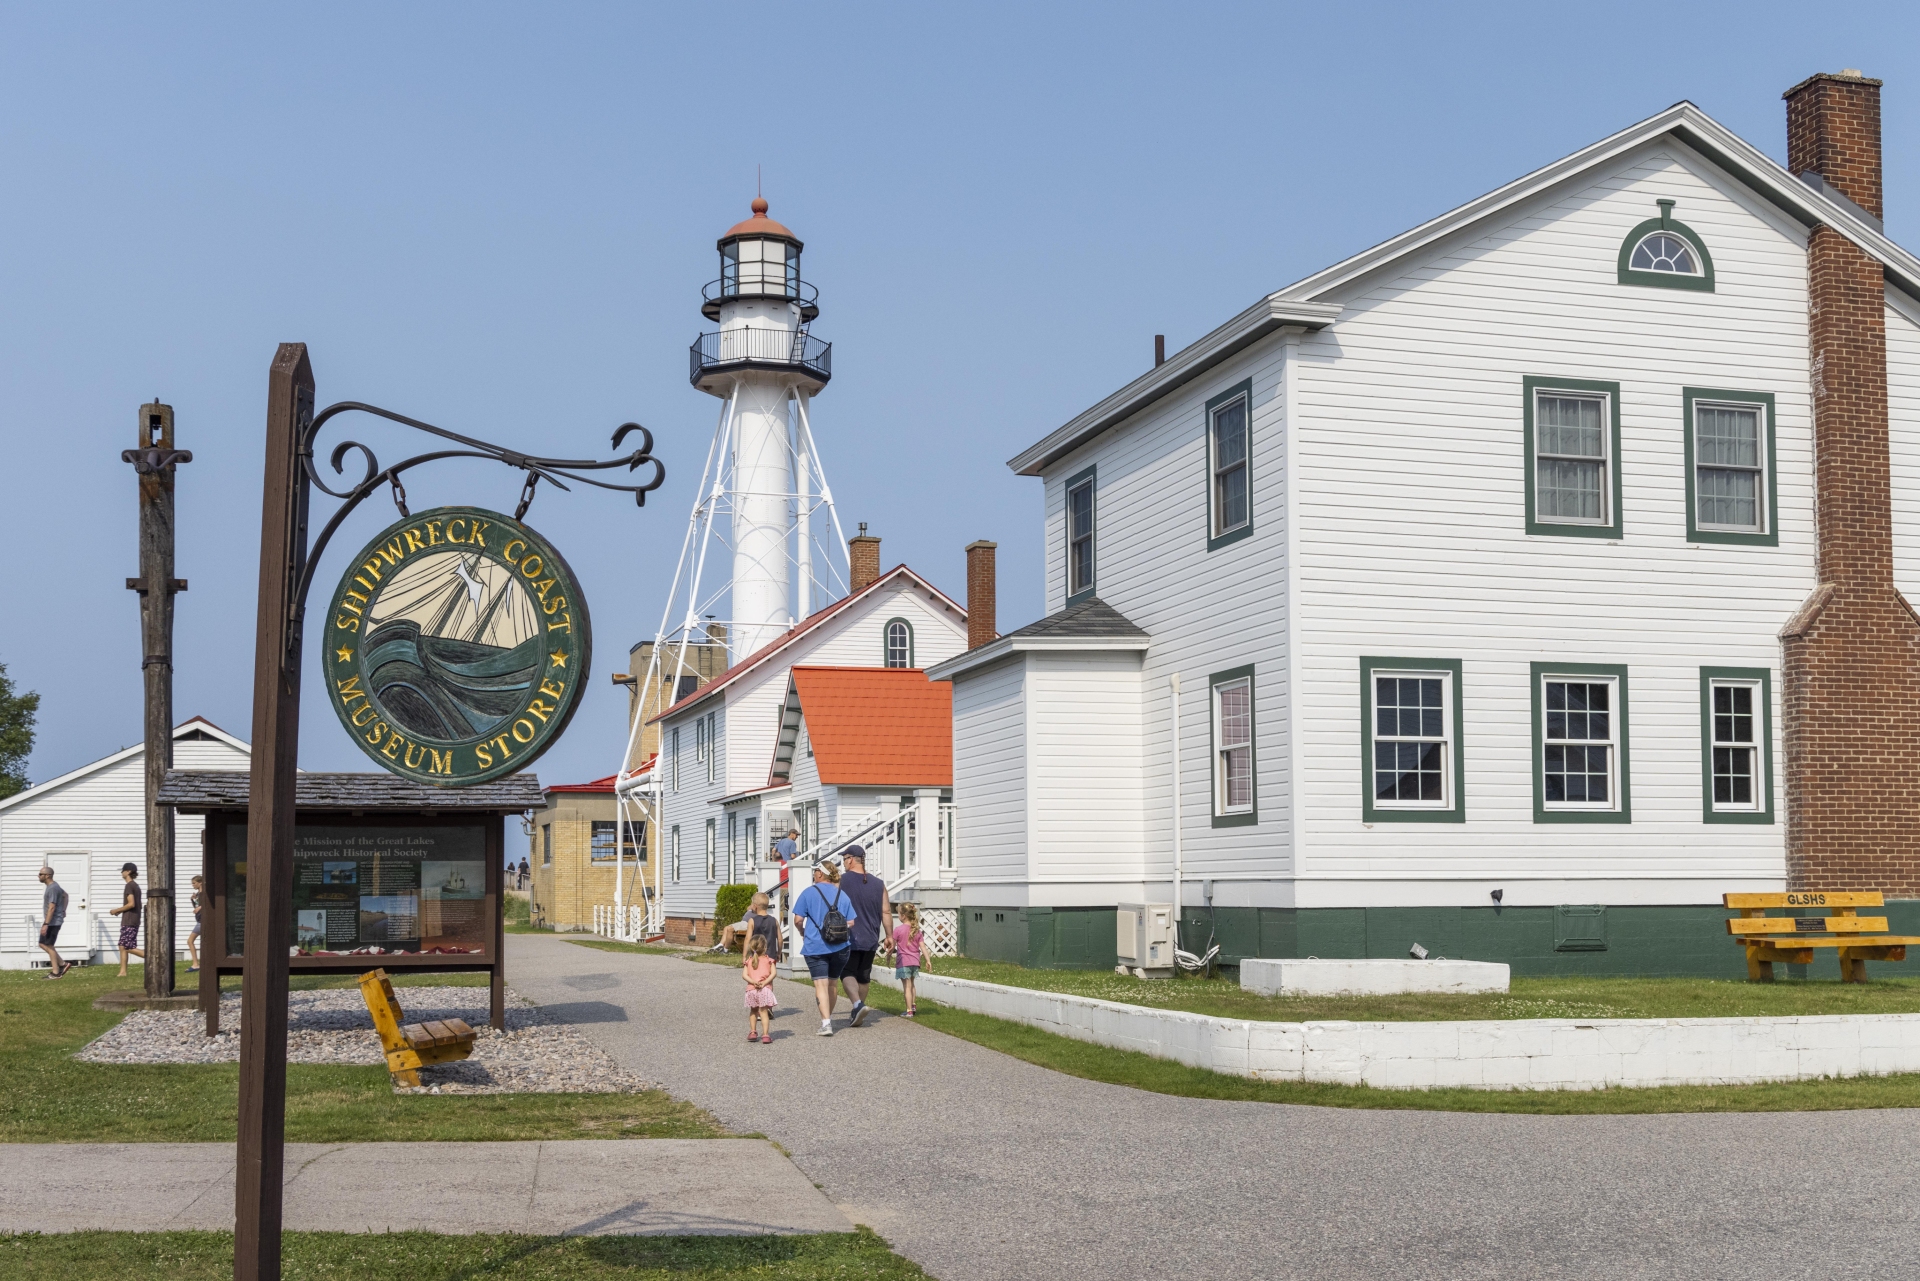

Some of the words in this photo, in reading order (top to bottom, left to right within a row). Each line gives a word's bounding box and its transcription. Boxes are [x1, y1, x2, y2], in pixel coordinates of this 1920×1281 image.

[337, 519, 491, 633] SHIPWRECK
[503, 539, 573, 635] COAST
[337, 673, 454, 775] MUSEUM
[475, 678, 566, 770] STORE
[303, 837, 343, 846] Mission
[345, 836, 357, 846] of
[358, 837, 374, 846] the
[376, 836, 404, 846] Great
[407, 836, 435, 846] Lakes
[293, 848, 340, 859] hipwreck
[343, 848, 391, 858] Historical
[393, 848, 429, 859] Society
[1787, 893, 1826, 905] GLSHS
